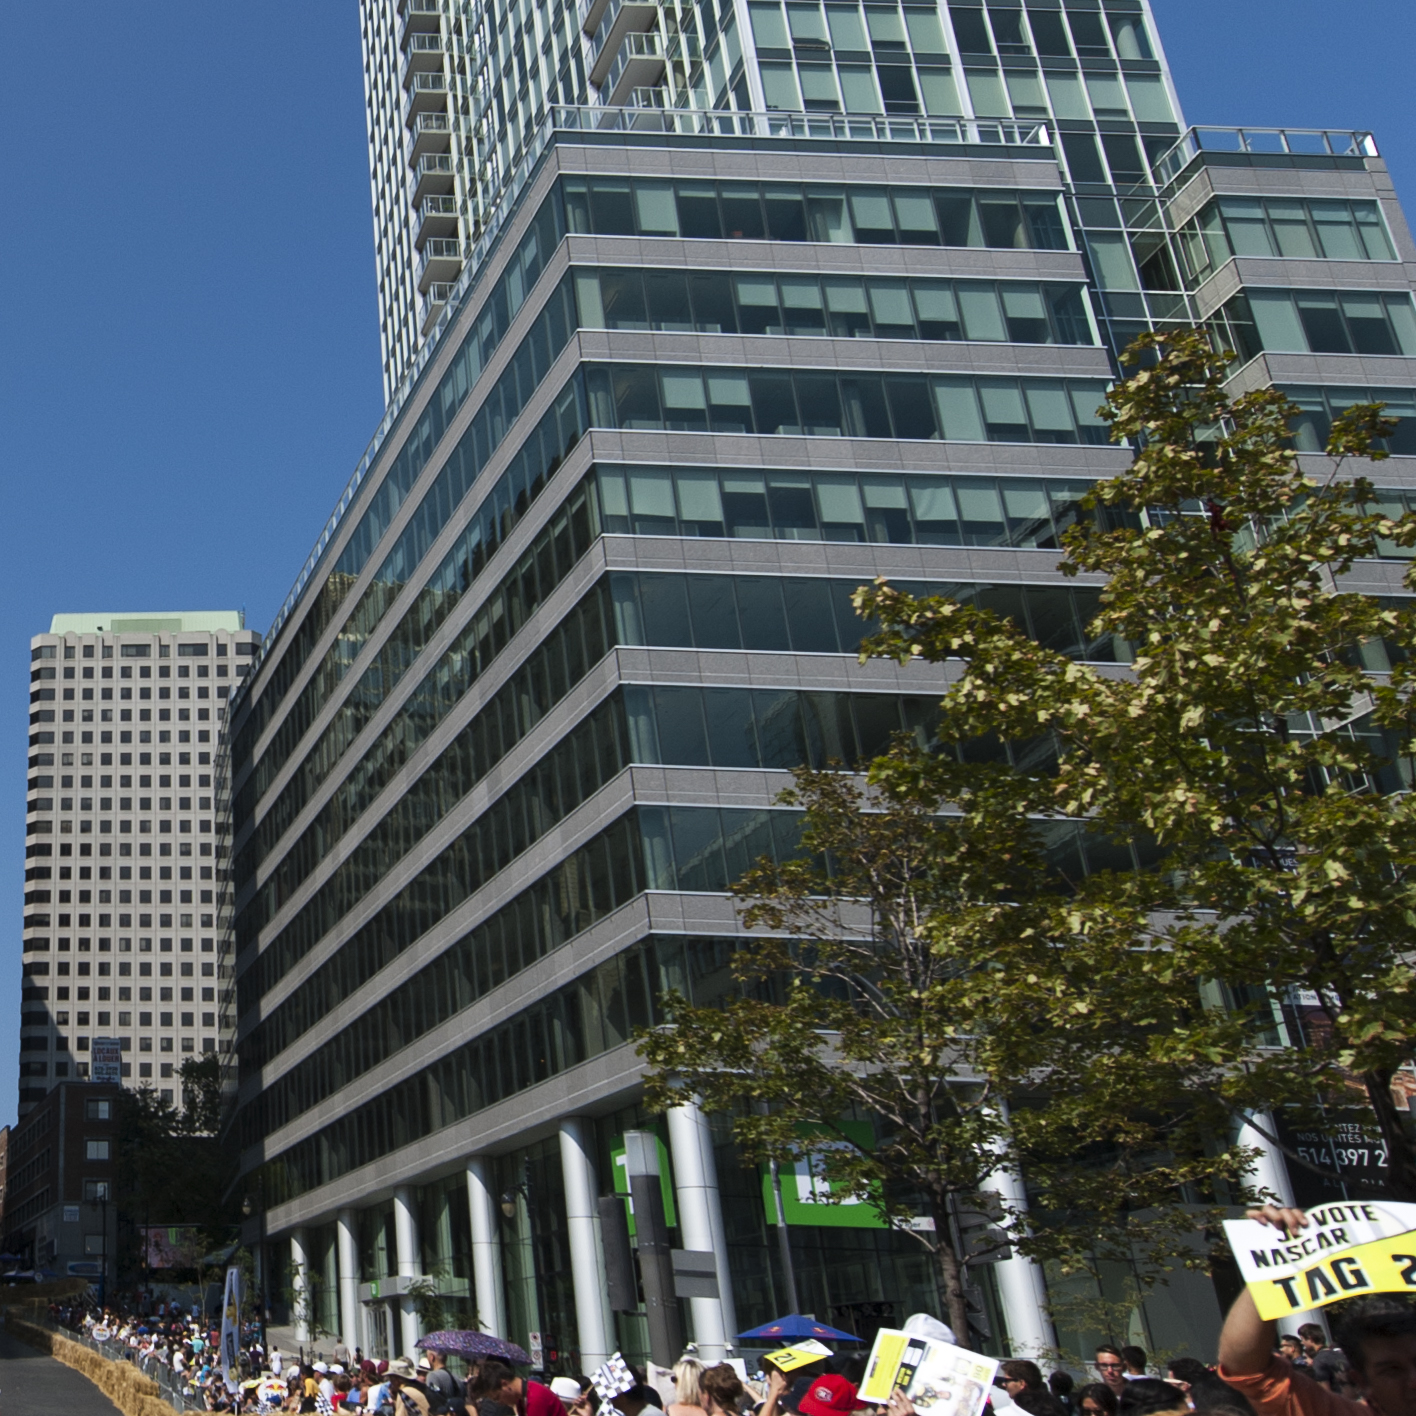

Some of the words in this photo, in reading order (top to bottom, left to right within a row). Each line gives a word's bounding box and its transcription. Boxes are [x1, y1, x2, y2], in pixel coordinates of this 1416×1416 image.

[1296, 1132, 1318, 1142] NOS
[1321, 1131, 1362, 1143] UITÉS
[1297, 1147, 1331, 1165] 514
[1337, 1148, 1369, 1167] 397
[1312, 1204, 1378, 1227] VOTE
[1250, 1227, 1350, 1269] NASCAR
[1272, 1256, 1371, 1310] TAG
